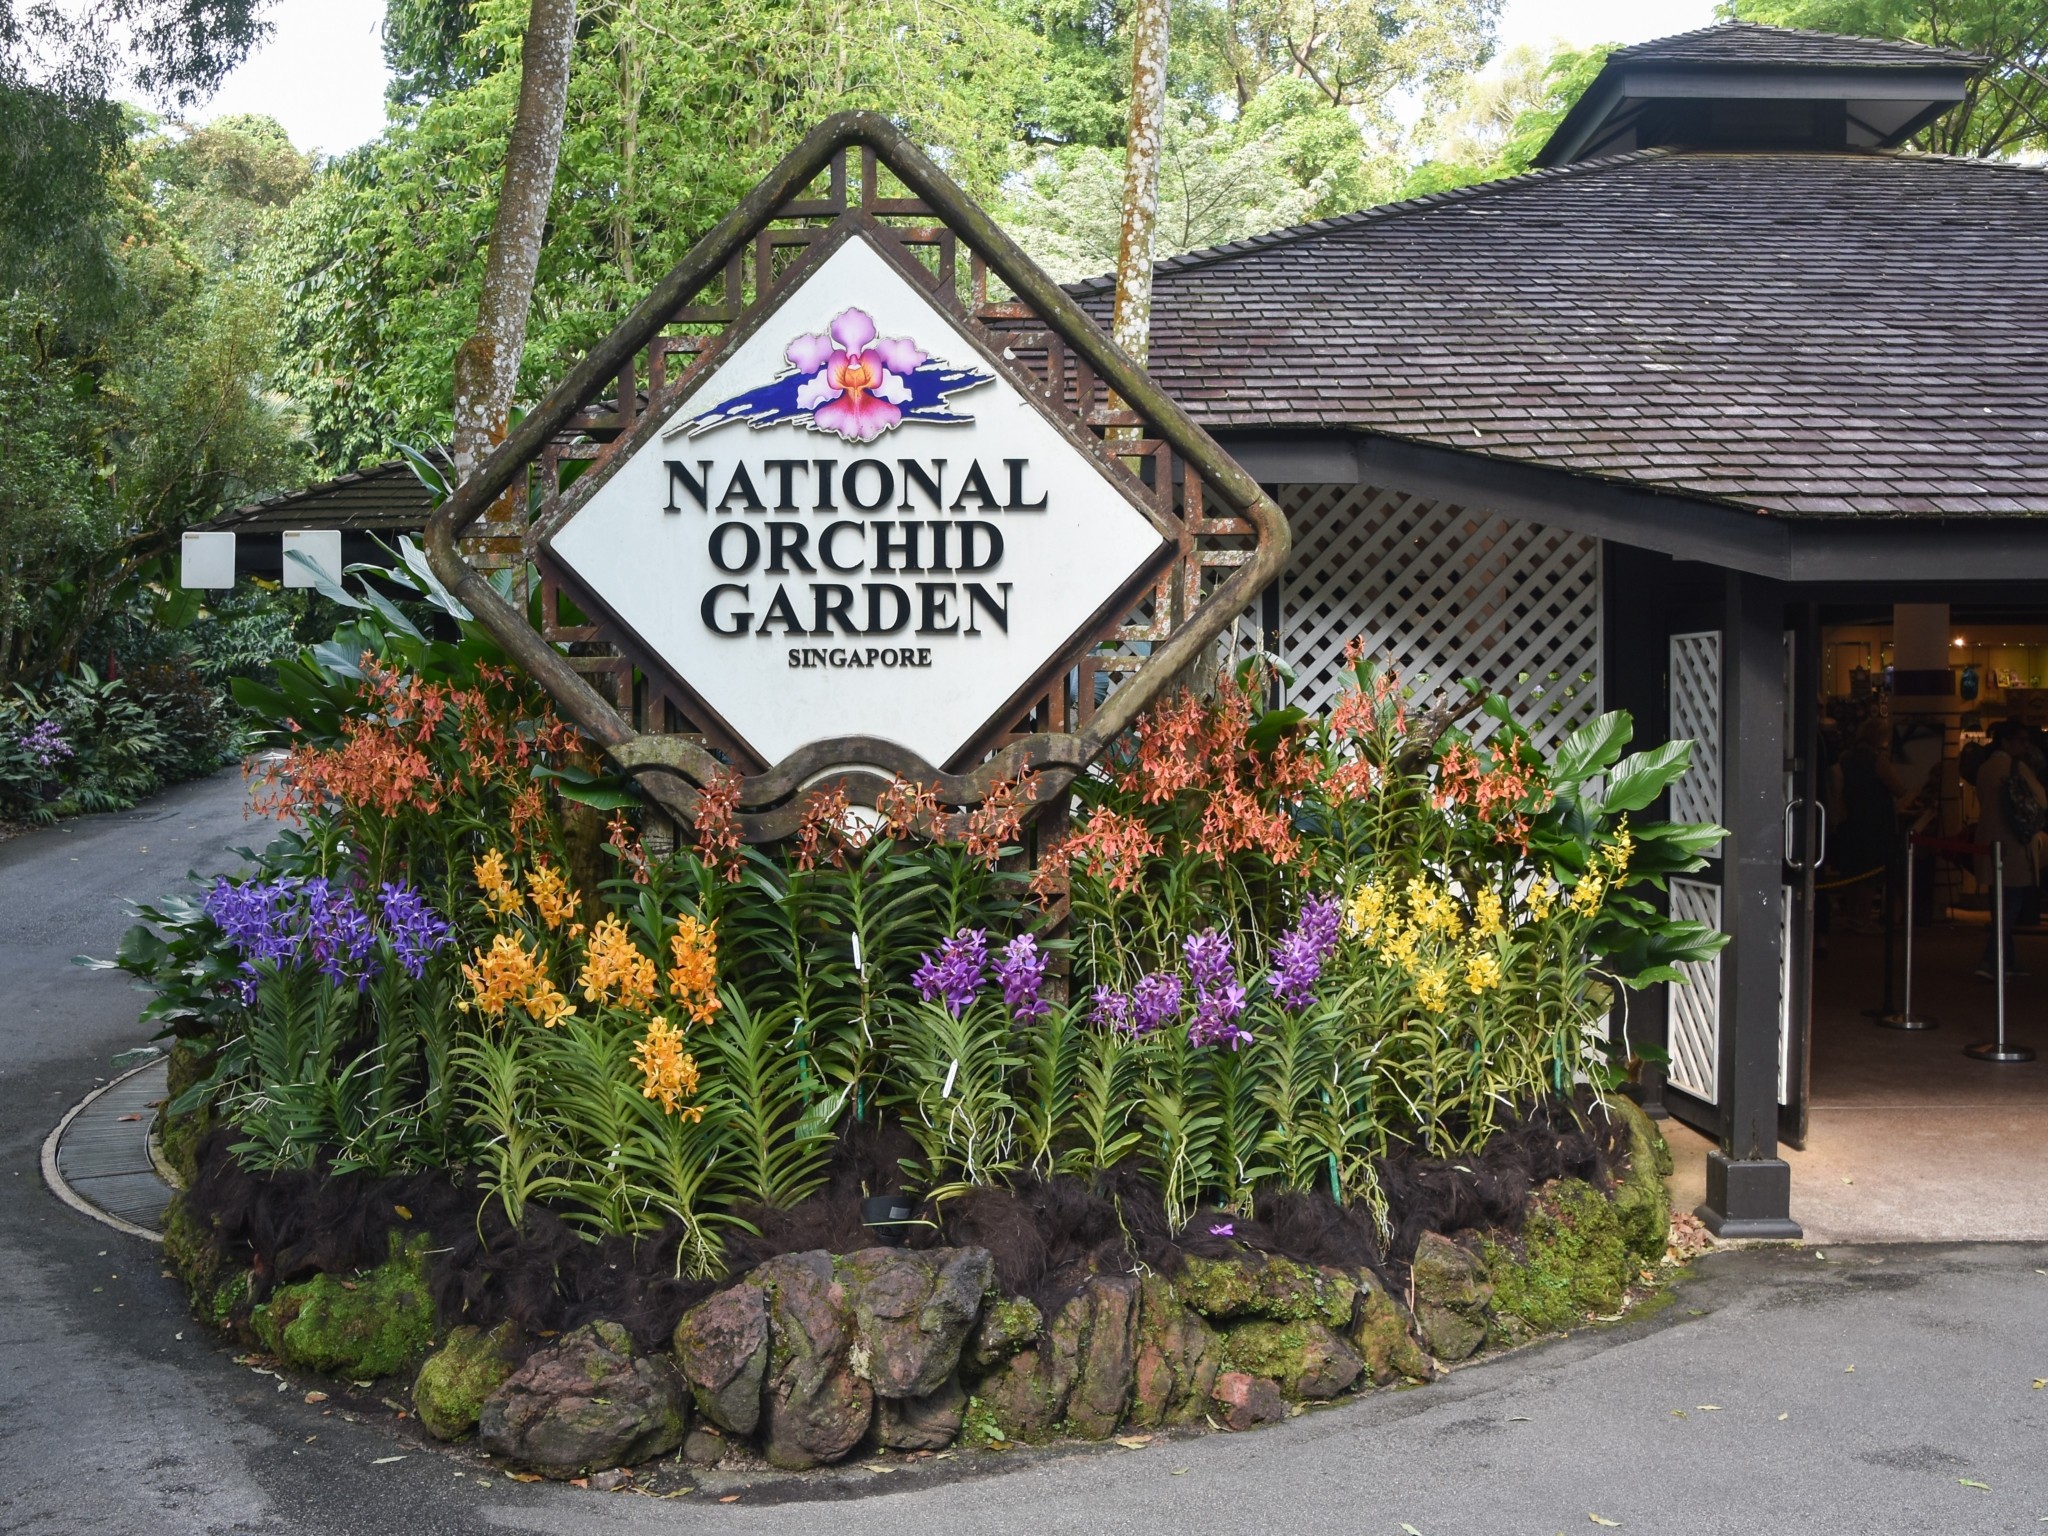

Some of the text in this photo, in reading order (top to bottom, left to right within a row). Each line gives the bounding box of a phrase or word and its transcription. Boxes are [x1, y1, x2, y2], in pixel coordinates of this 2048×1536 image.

[662, 458, 1049, 514] NATIONAL
[708, 520, 1005, 575] ORCHID
[700, 582, 1013, 638] GARDEN
[788, 648, 933, 669] SINGAPORE
